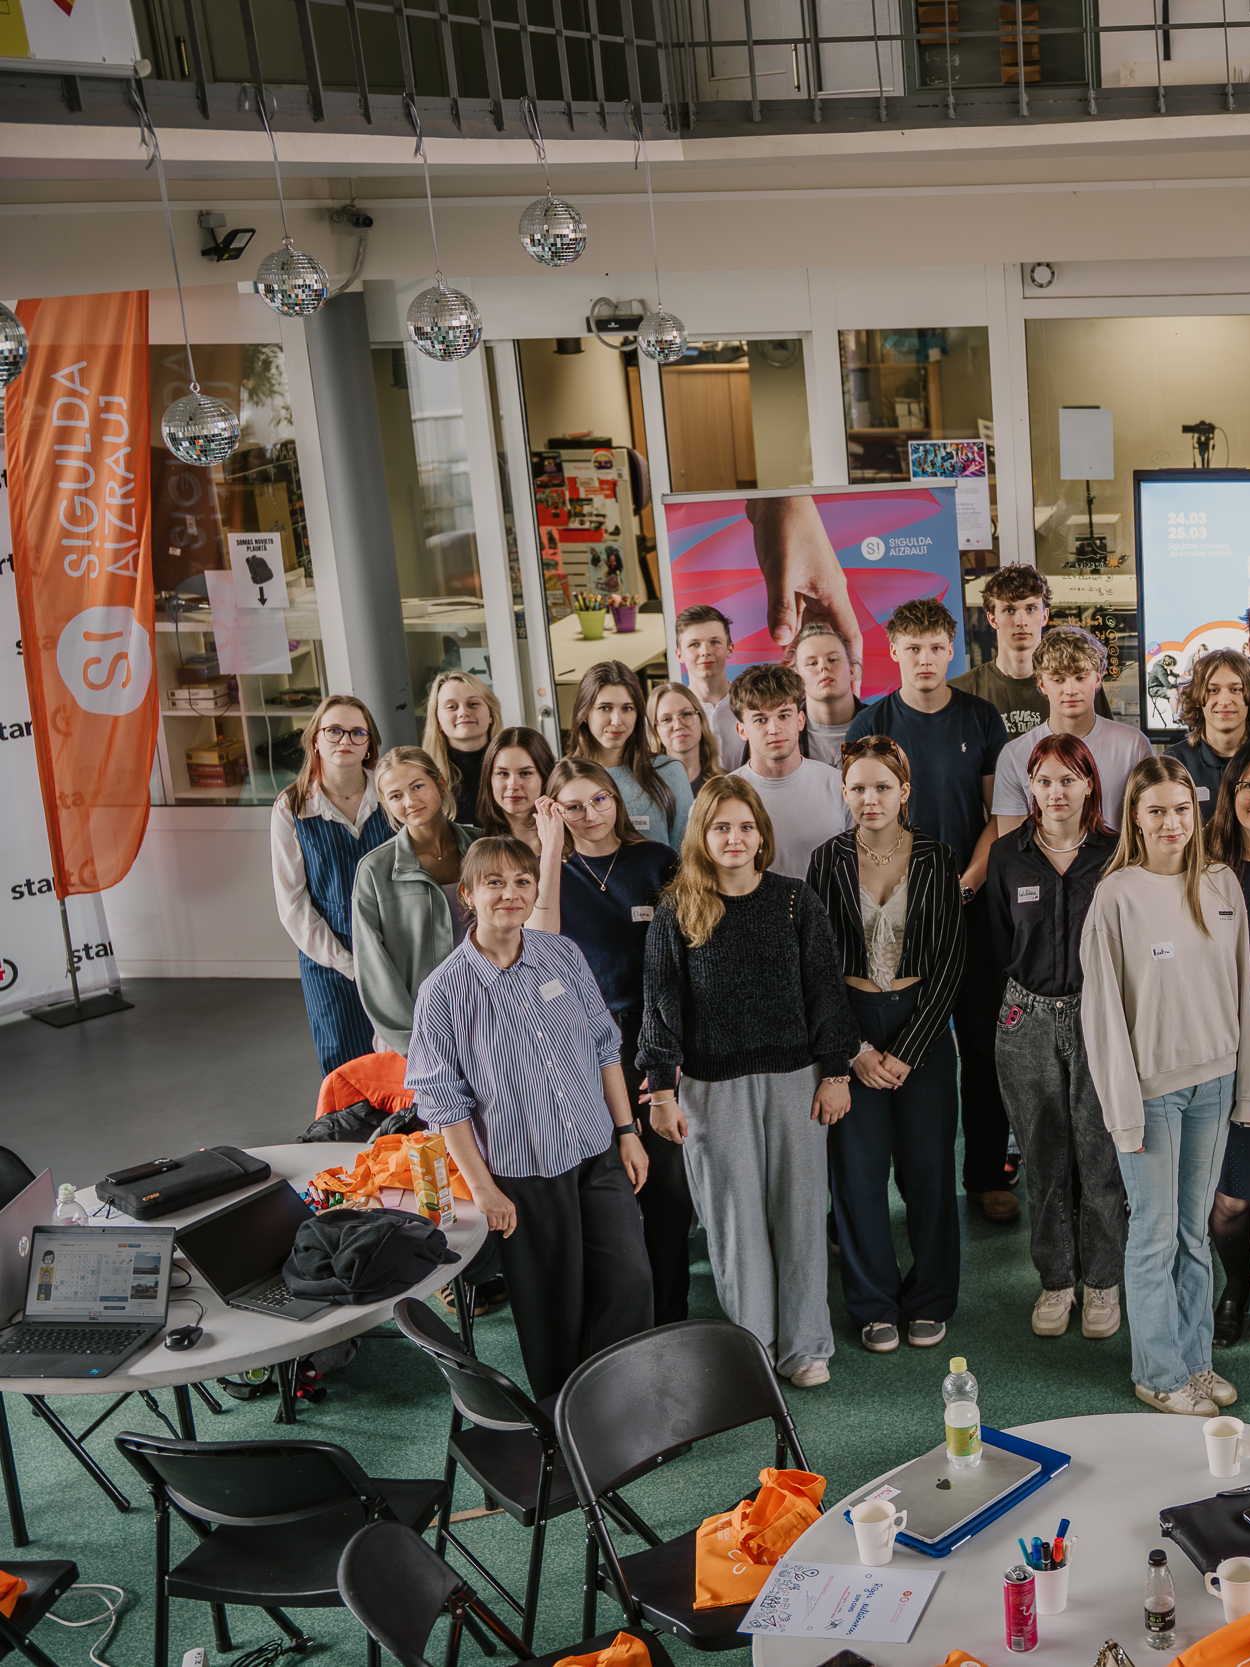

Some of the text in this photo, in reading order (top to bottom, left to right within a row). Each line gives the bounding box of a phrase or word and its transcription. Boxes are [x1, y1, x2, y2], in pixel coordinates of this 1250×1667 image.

[99, 395, 140, 578] AIZRAUJ
[1168, 512, 1207, 525] 24.03
[1168, 527, 1207, 539] 25.03
[1199, 542, 1228, 550] novada
[1010, 710, 1041, 723] GUESS
